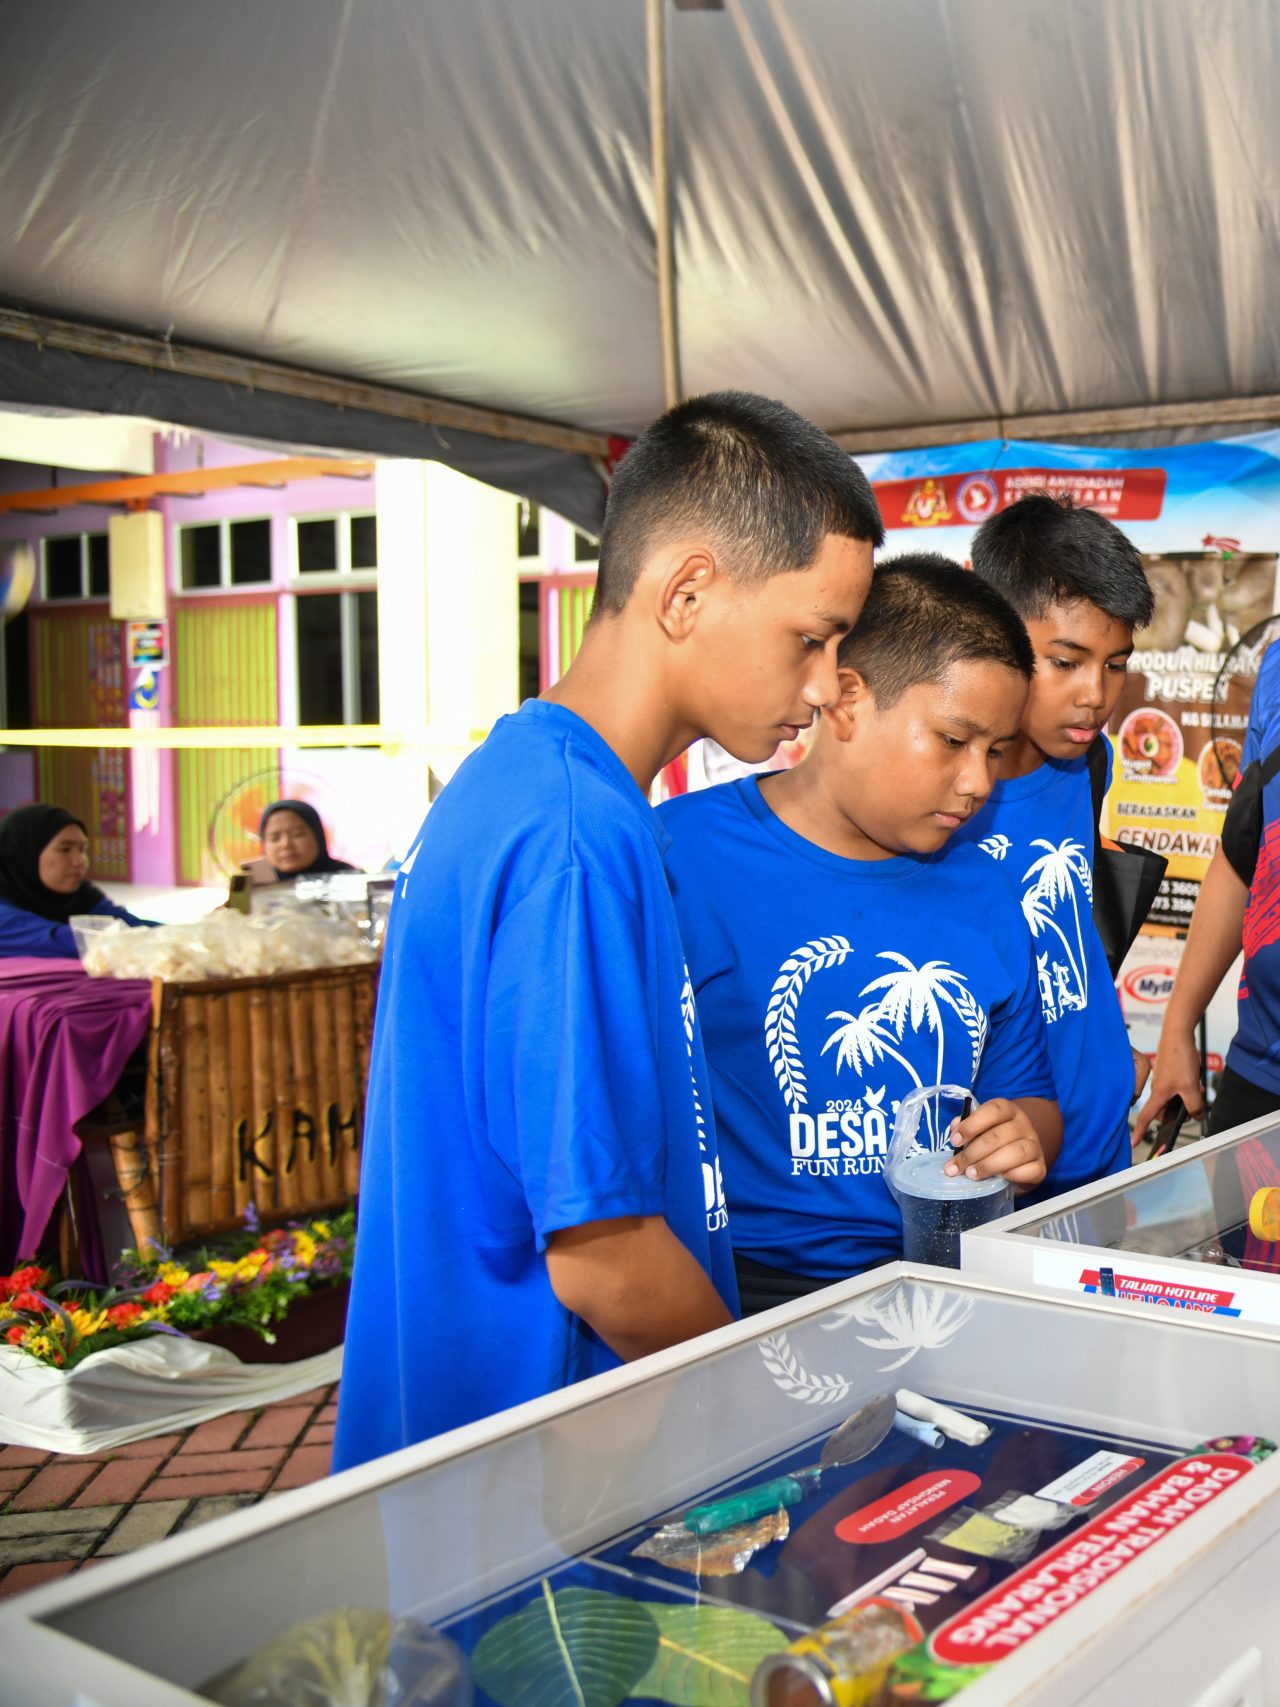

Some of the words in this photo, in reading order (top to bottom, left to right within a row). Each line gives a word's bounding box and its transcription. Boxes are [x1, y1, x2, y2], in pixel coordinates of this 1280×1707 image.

[1117, 828, 1220, 854] CENDAWA
[826, 1099, 864, 1115] 2024
[789, 1109, 888, 1158] DESA
[791, 1157, 839, 1177] FUN
[842, 1155, 888, 1176] RUN
[1119, 1278, 1164, 1295] TALIAN
[1164, 1285, 1219, 1304] HOTLINE
[1182, 1461, 1213, 1475] &
[889, 1490, 947, 1524] PERALATAN
[898, 1478, 952, 1511] MENGHISAP
[1103, 1475, 1194, 1535] BAHAN
[1151, 1466, 1241, 1527] DADAH
[858, 1509, 897, 1533] DADAH
[949, 1532, 1117, 1646] TERLARANG
[985, 1523, 1166, 1648] TRADISIONAL
